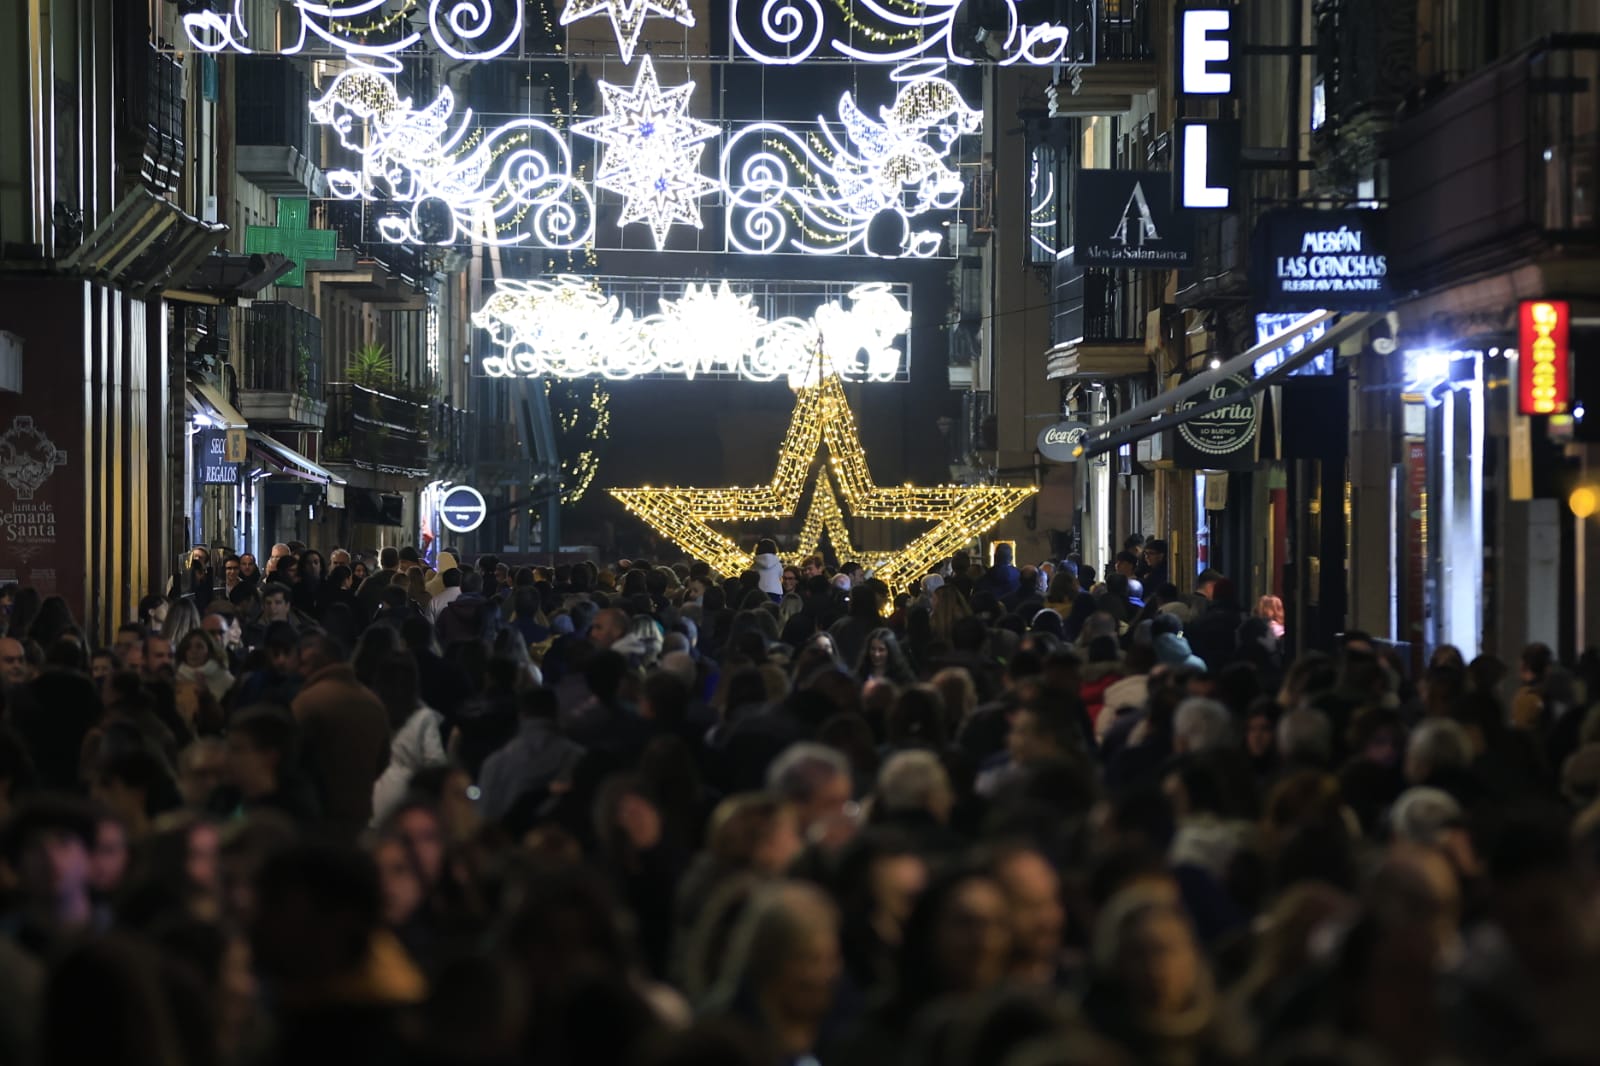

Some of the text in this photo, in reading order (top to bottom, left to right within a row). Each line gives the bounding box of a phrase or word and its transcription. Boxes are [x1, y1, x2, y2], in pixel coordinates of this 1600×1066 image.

[1302, 225, 1362, 253] MESÓN
[1123, 247, 1187, 260] Salamanca
[1277, 255, 1387, 278] LAS CONCHAS
[205, 466, 238, 482] REGALOS
[39, 501, 53, 512] de
[7, 524, 56, 541] Santa
